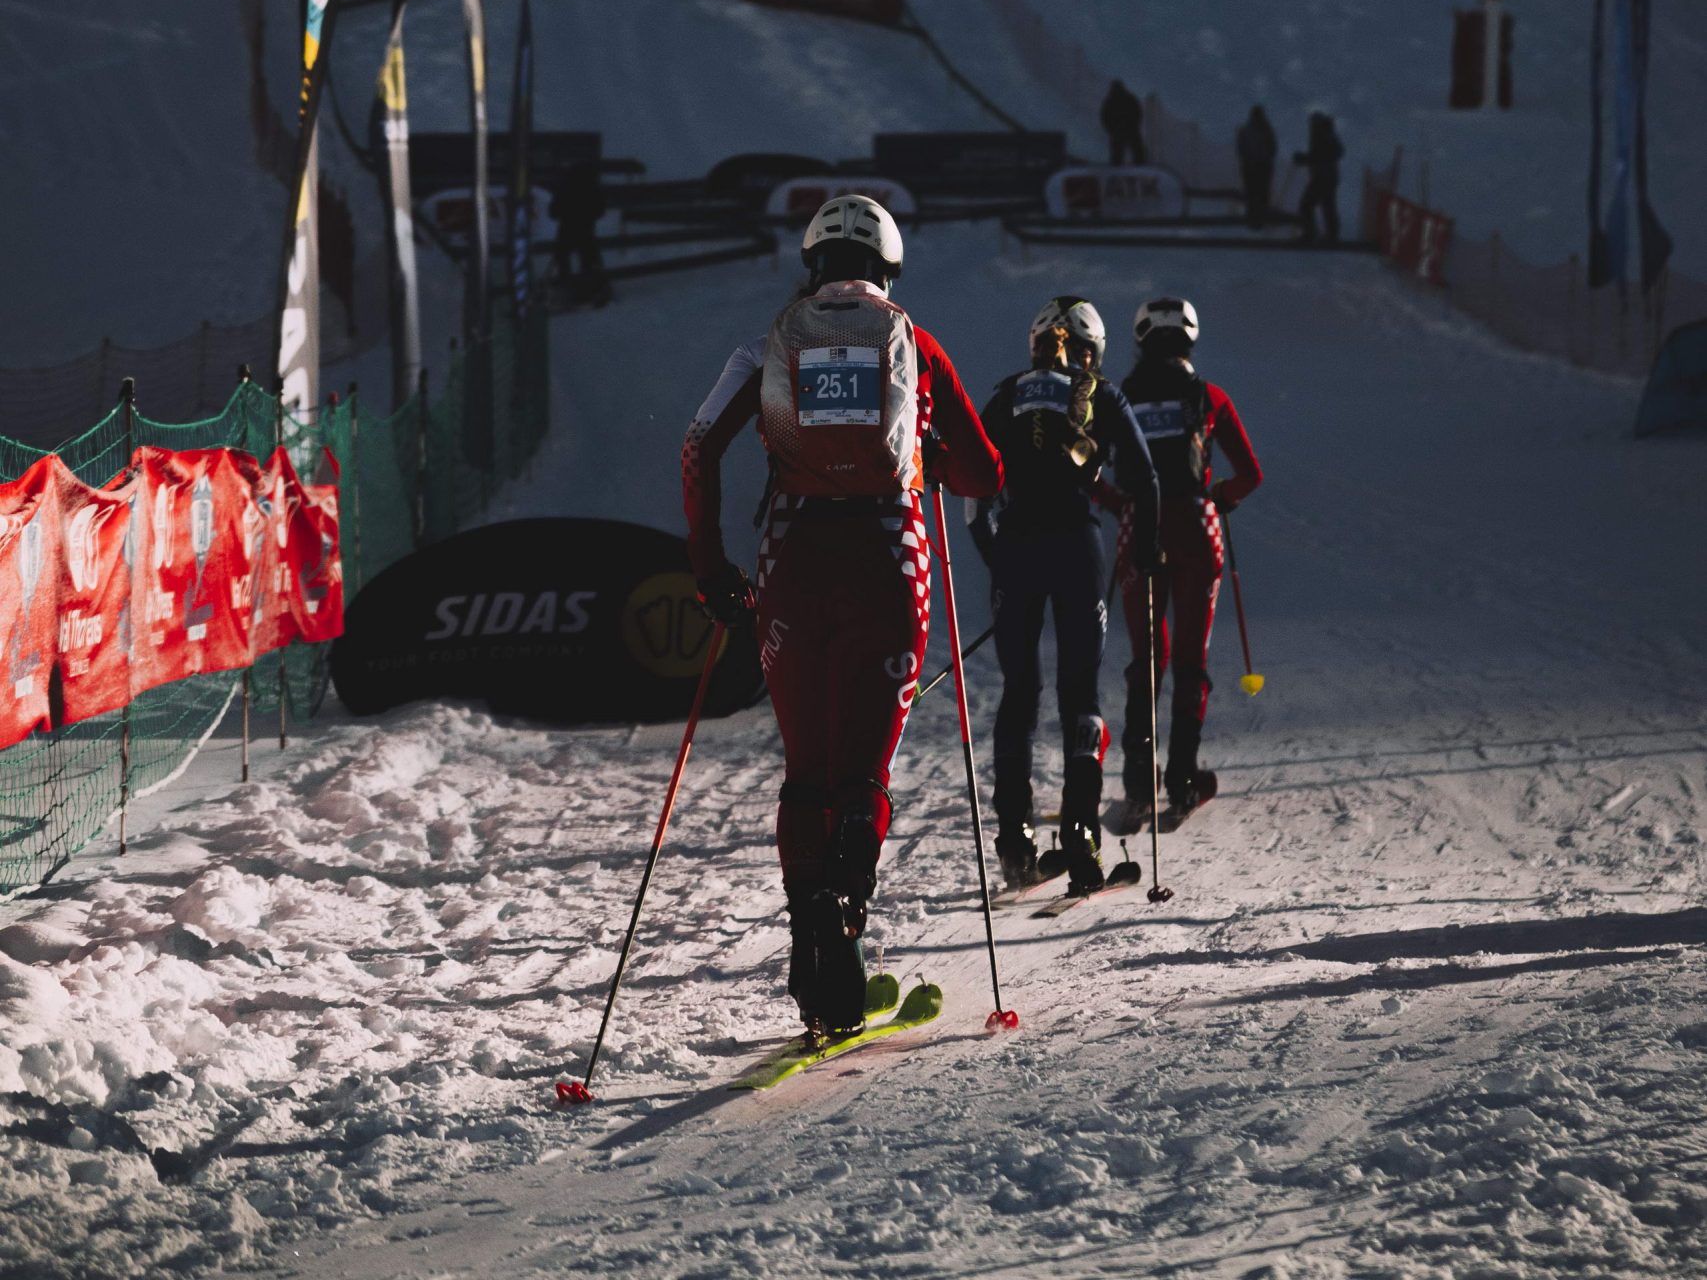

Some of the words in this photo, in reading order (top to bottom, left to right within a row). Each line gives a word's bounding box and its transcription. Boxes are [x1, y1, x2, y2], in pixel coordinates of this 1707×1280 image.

[816, 373, 858, 399] 25.1
[1025, 384, 1055, 397] 24.1
[424, 591, 598, 640] SIDAS
